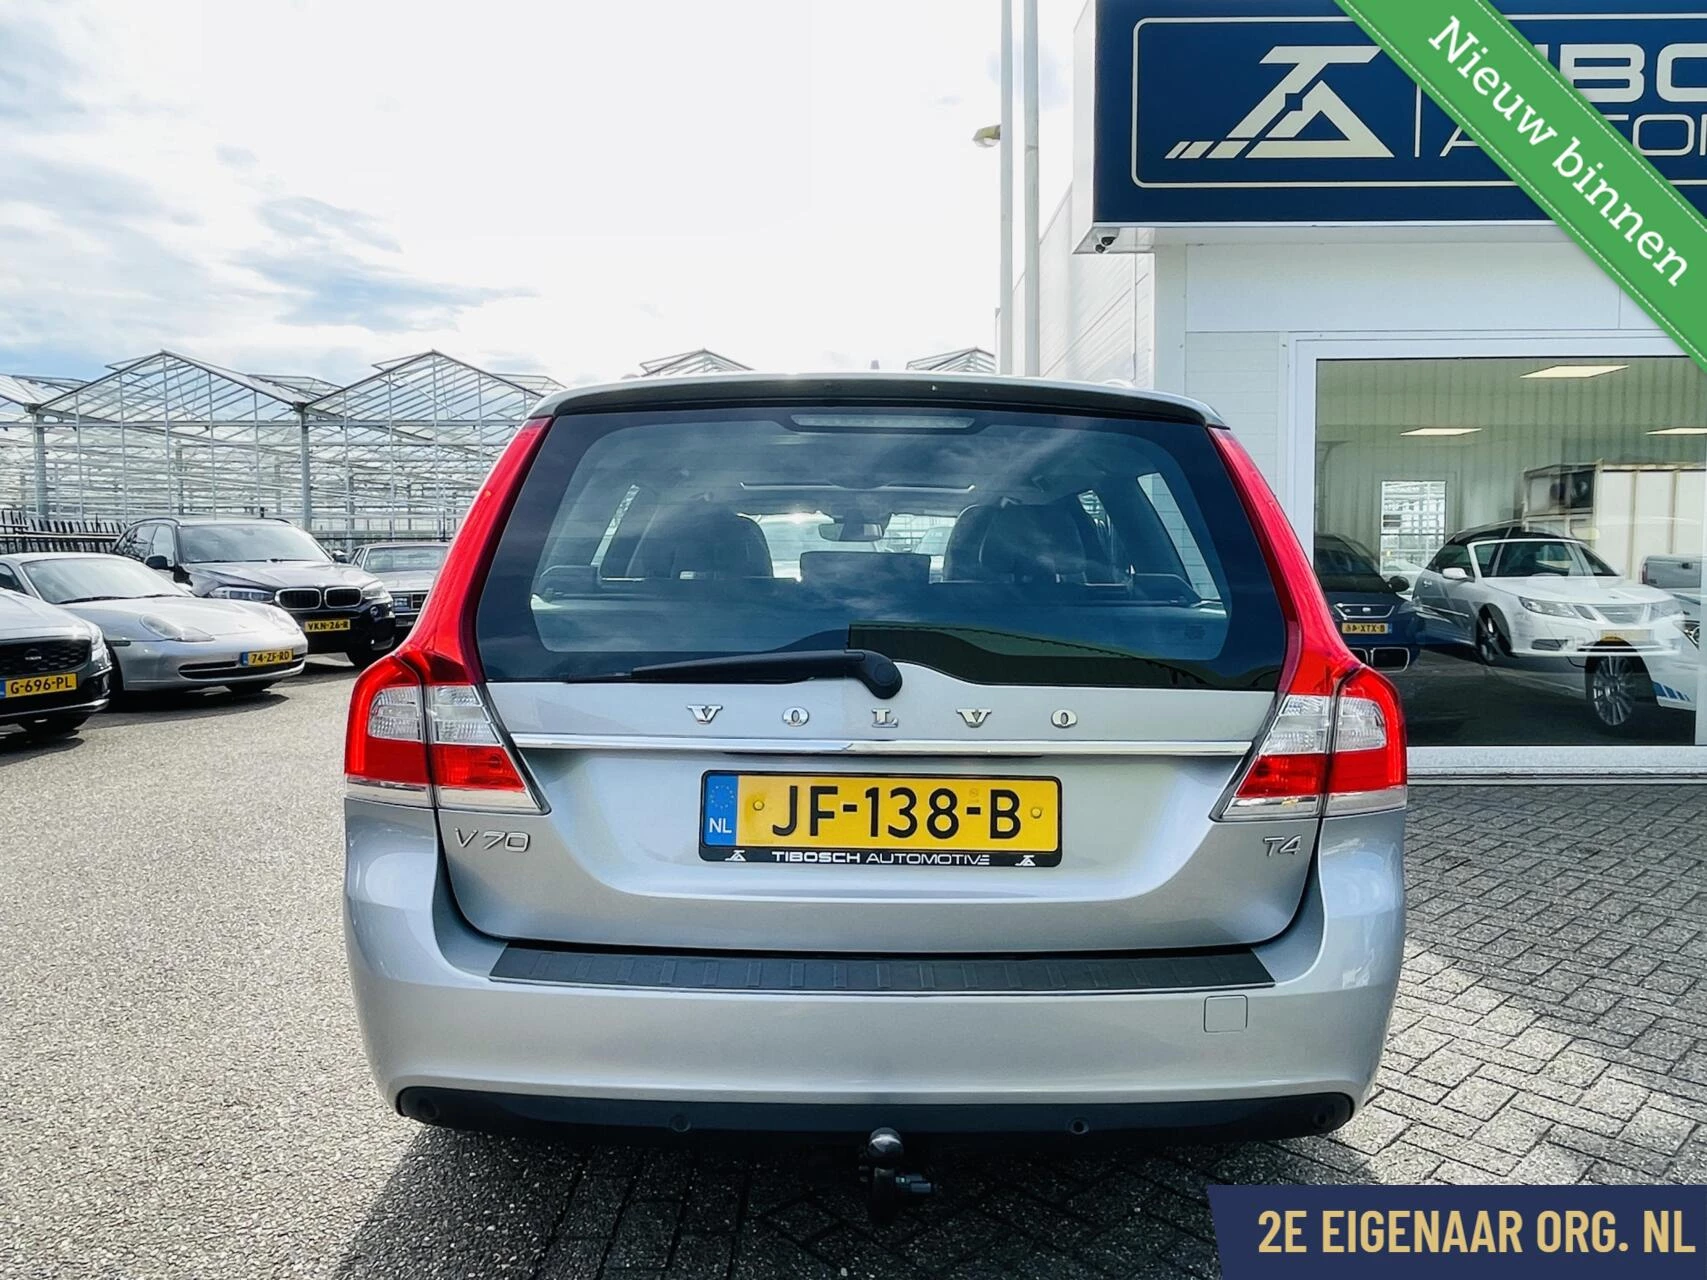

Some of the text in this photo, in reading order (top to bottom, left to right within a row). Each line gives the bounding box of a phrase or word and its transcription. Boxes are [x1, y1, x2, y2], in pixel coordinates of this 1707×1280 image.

[251, 651, 289, 663] 74-ZF-RD
[10, 676, 72, 694] G-696-PL
[688, 704, 1079, 729] VOLVO
[772, 785, 1021, 840] JF-138-B
[709, 817, 732, 834] NL
[1263, 835, 1301, 856] T4
[772, 851, 990, 865] TIBOSCH AUTOMOTIVE
